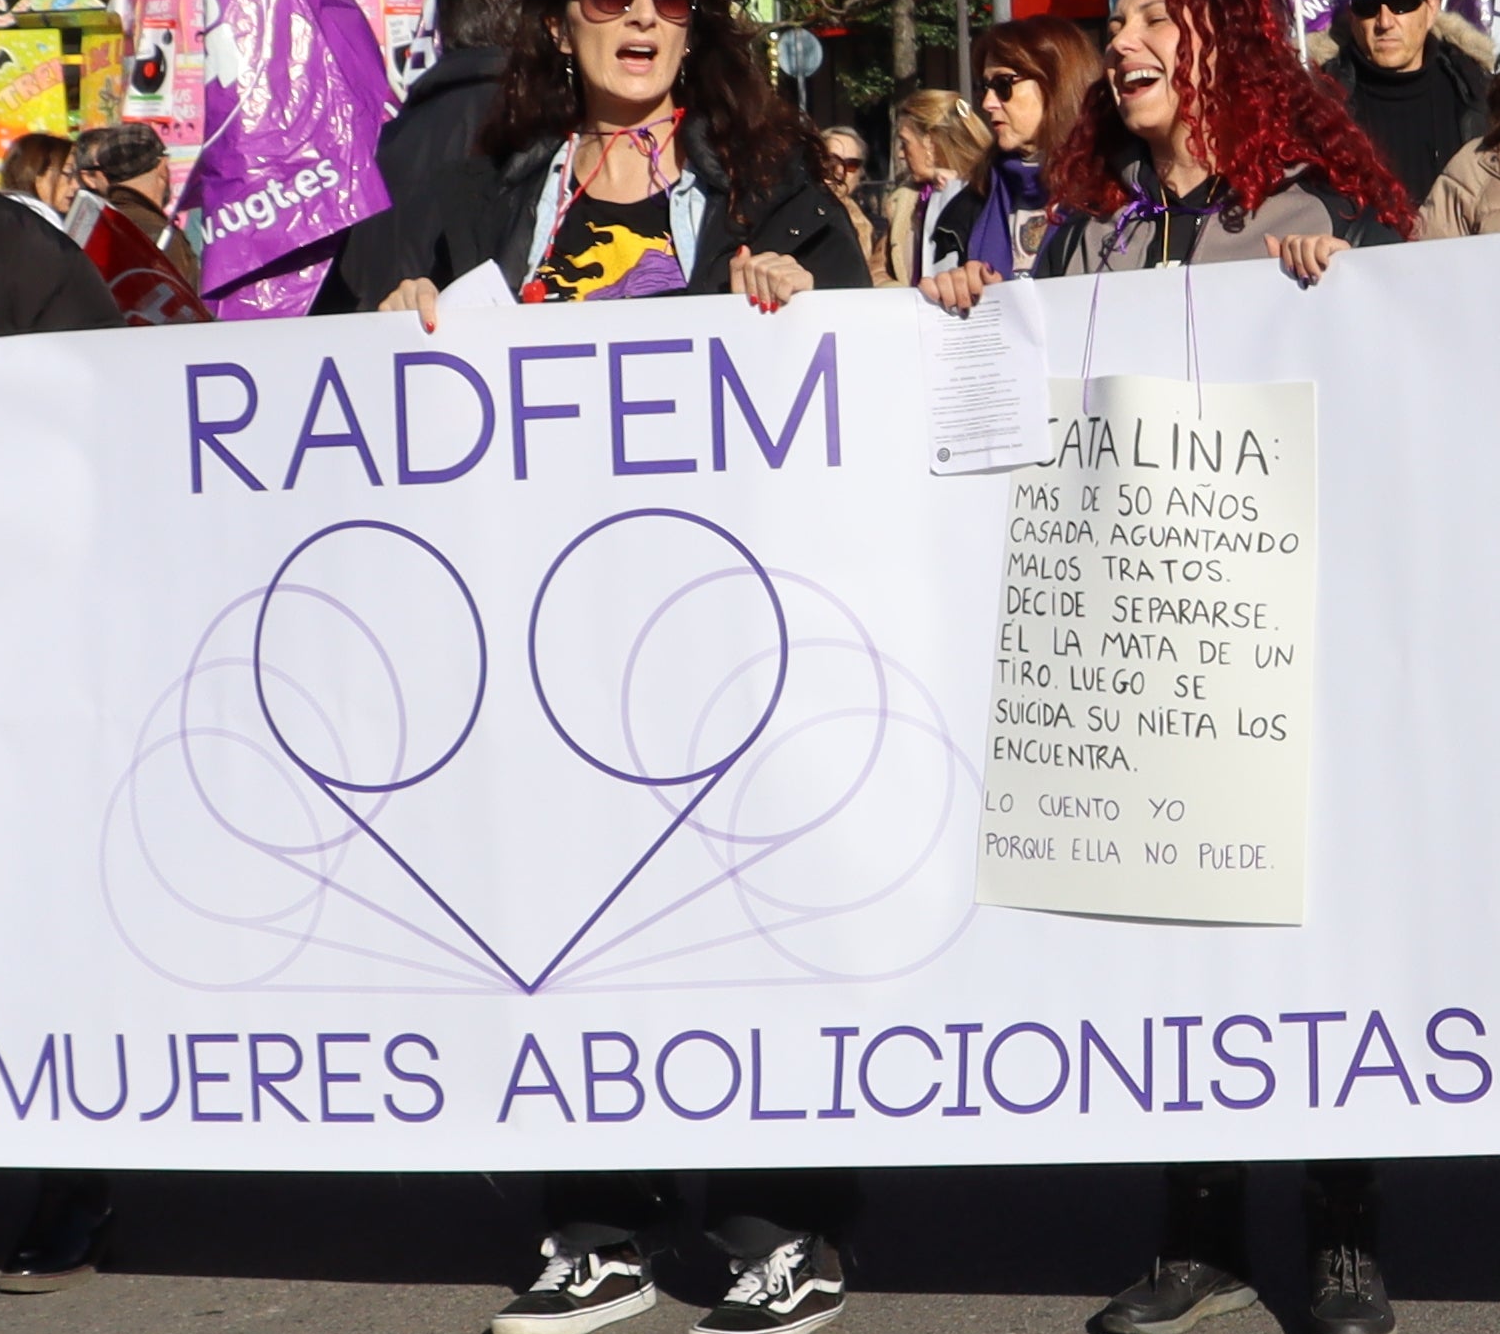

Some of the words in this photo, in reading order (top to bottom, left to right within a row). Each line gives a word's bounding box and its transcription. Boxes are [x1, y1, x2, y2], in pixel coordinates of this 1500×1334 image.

[184, 331, 842, 494] RADFEM
[1014, 481, 1060, 514] MÁS
[1081, 484, 1100, 514] DE
[1117, 484, 1152, 518] 50
[1165, 483, 1258, 523] AÑOS
[1009, 518, 1099, 547] CASADA,
[1110, 522, 1299, 556] AGUANTANDO
[1007, 554, 1081, 583] MALOS
[1102, 556, 1231, 584] TRATOS.
[1006, 585, 1086, 619] DECIDE
[1111, 595, 1281, 633] SEPARARSE.
[1000, 623, 1029, 655] ÉL
[1052, 628, 1082, 659] LA
[1101, 631, 1177, 664] MATA
[1198, 639, 1231, 667] DE
[1255, 642, 1294, 669] UN
[997, 659, 1059, 689] TIRO.
[1069, 667, 1145, 696] LUEGO
[1174, 673, 1206, 701] SE
[1087, 705, 1121, 734] SU
[1138, 706, 1216, 740] NIETA
[1238, 708, 1288, 742] LOS
[993, 736, 1139, 773] ENCUENTRA.
[494, 1005, 1496, 1125] ABOLICIONISTAS
